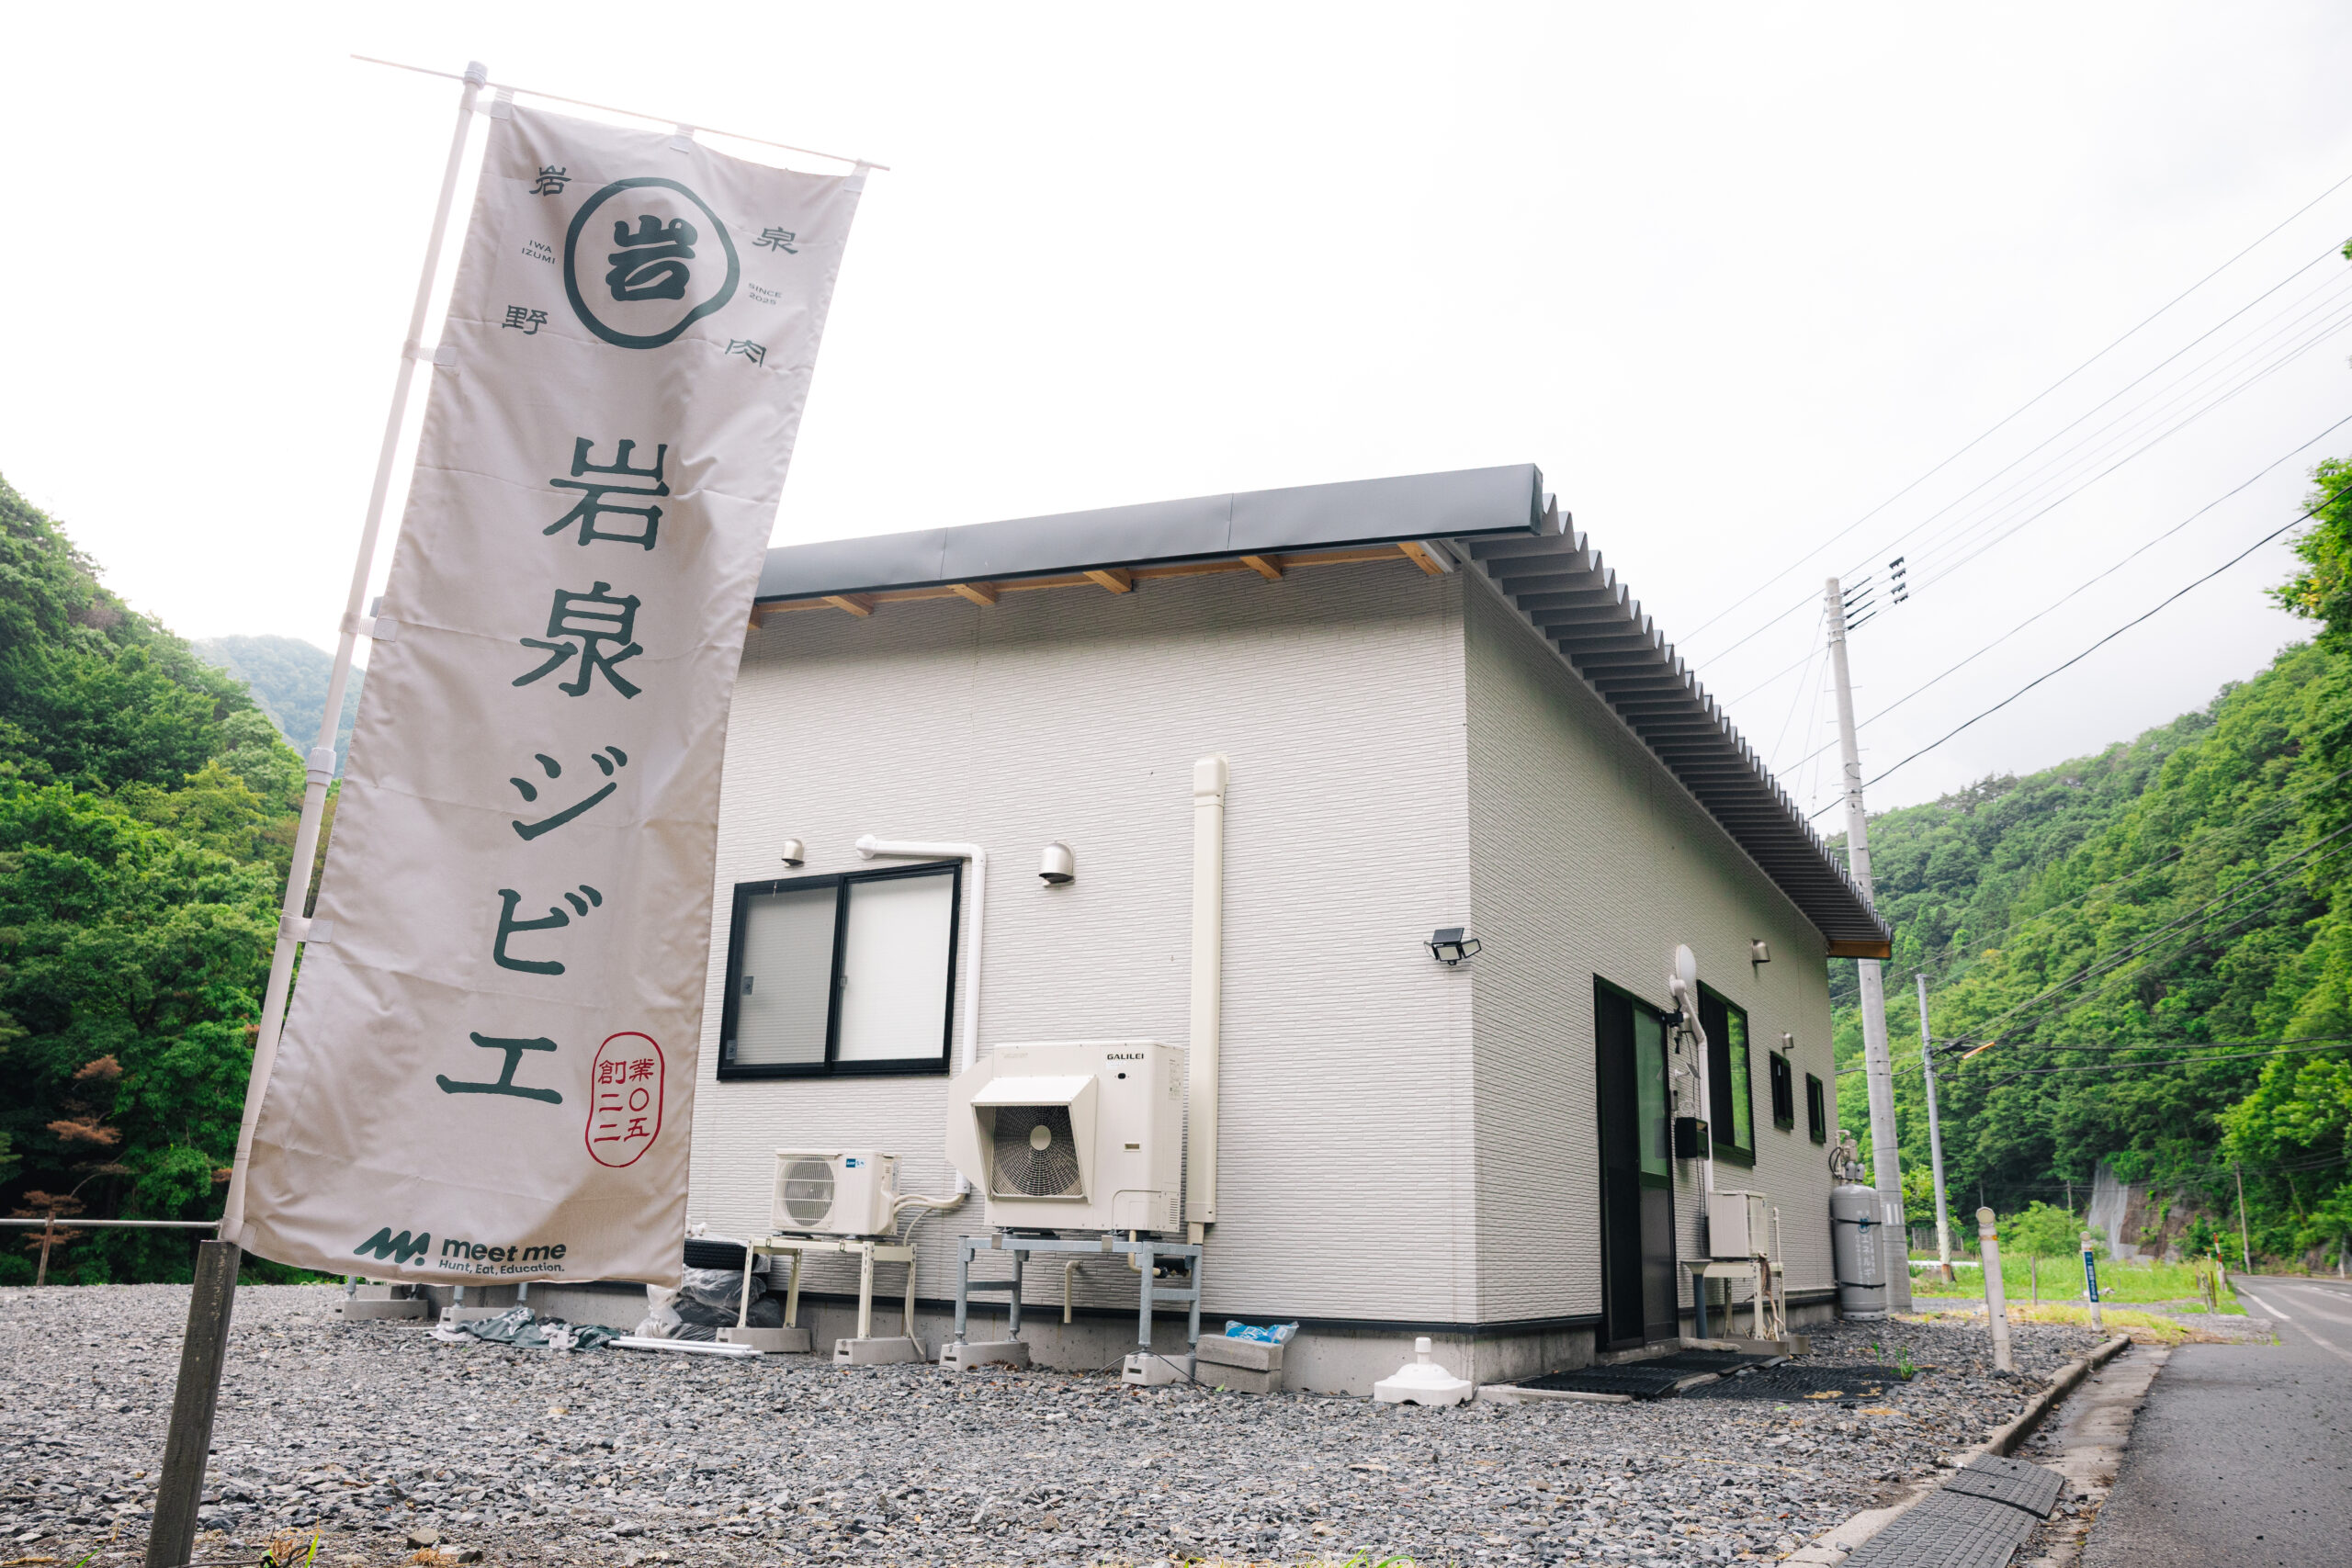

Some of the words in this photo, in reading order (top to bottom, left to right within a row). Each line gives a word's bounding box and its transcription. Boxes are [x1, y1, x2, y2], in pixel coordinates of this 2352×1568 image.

[529, 165, 571, 197] 岩
[529, 240, 552, 254] IWA
[752, 226, 798, 254] 泉
[521, 247, 556, 265] IZUMI
[605, 214, 698, 301] 岩
[749, 283, 782, 299] SINCE
[502, 305, 548, 335] 野
[725, 338, 767, 367] 肉
[436, 436, 671, 1105] 岩泉ジビエ
[1106, 1053, 1145, 1061] GALILEI
[598, 1058, 654, 1085] 創業
[441, 1238, 519, 1263] meet
[522, 1244, 567, 1261] me
[438, 1258, 473, 1275] Hunt,
[475, 1263, 498, 1276] Eat,
[500, 1261, 565, 1275] Education.
